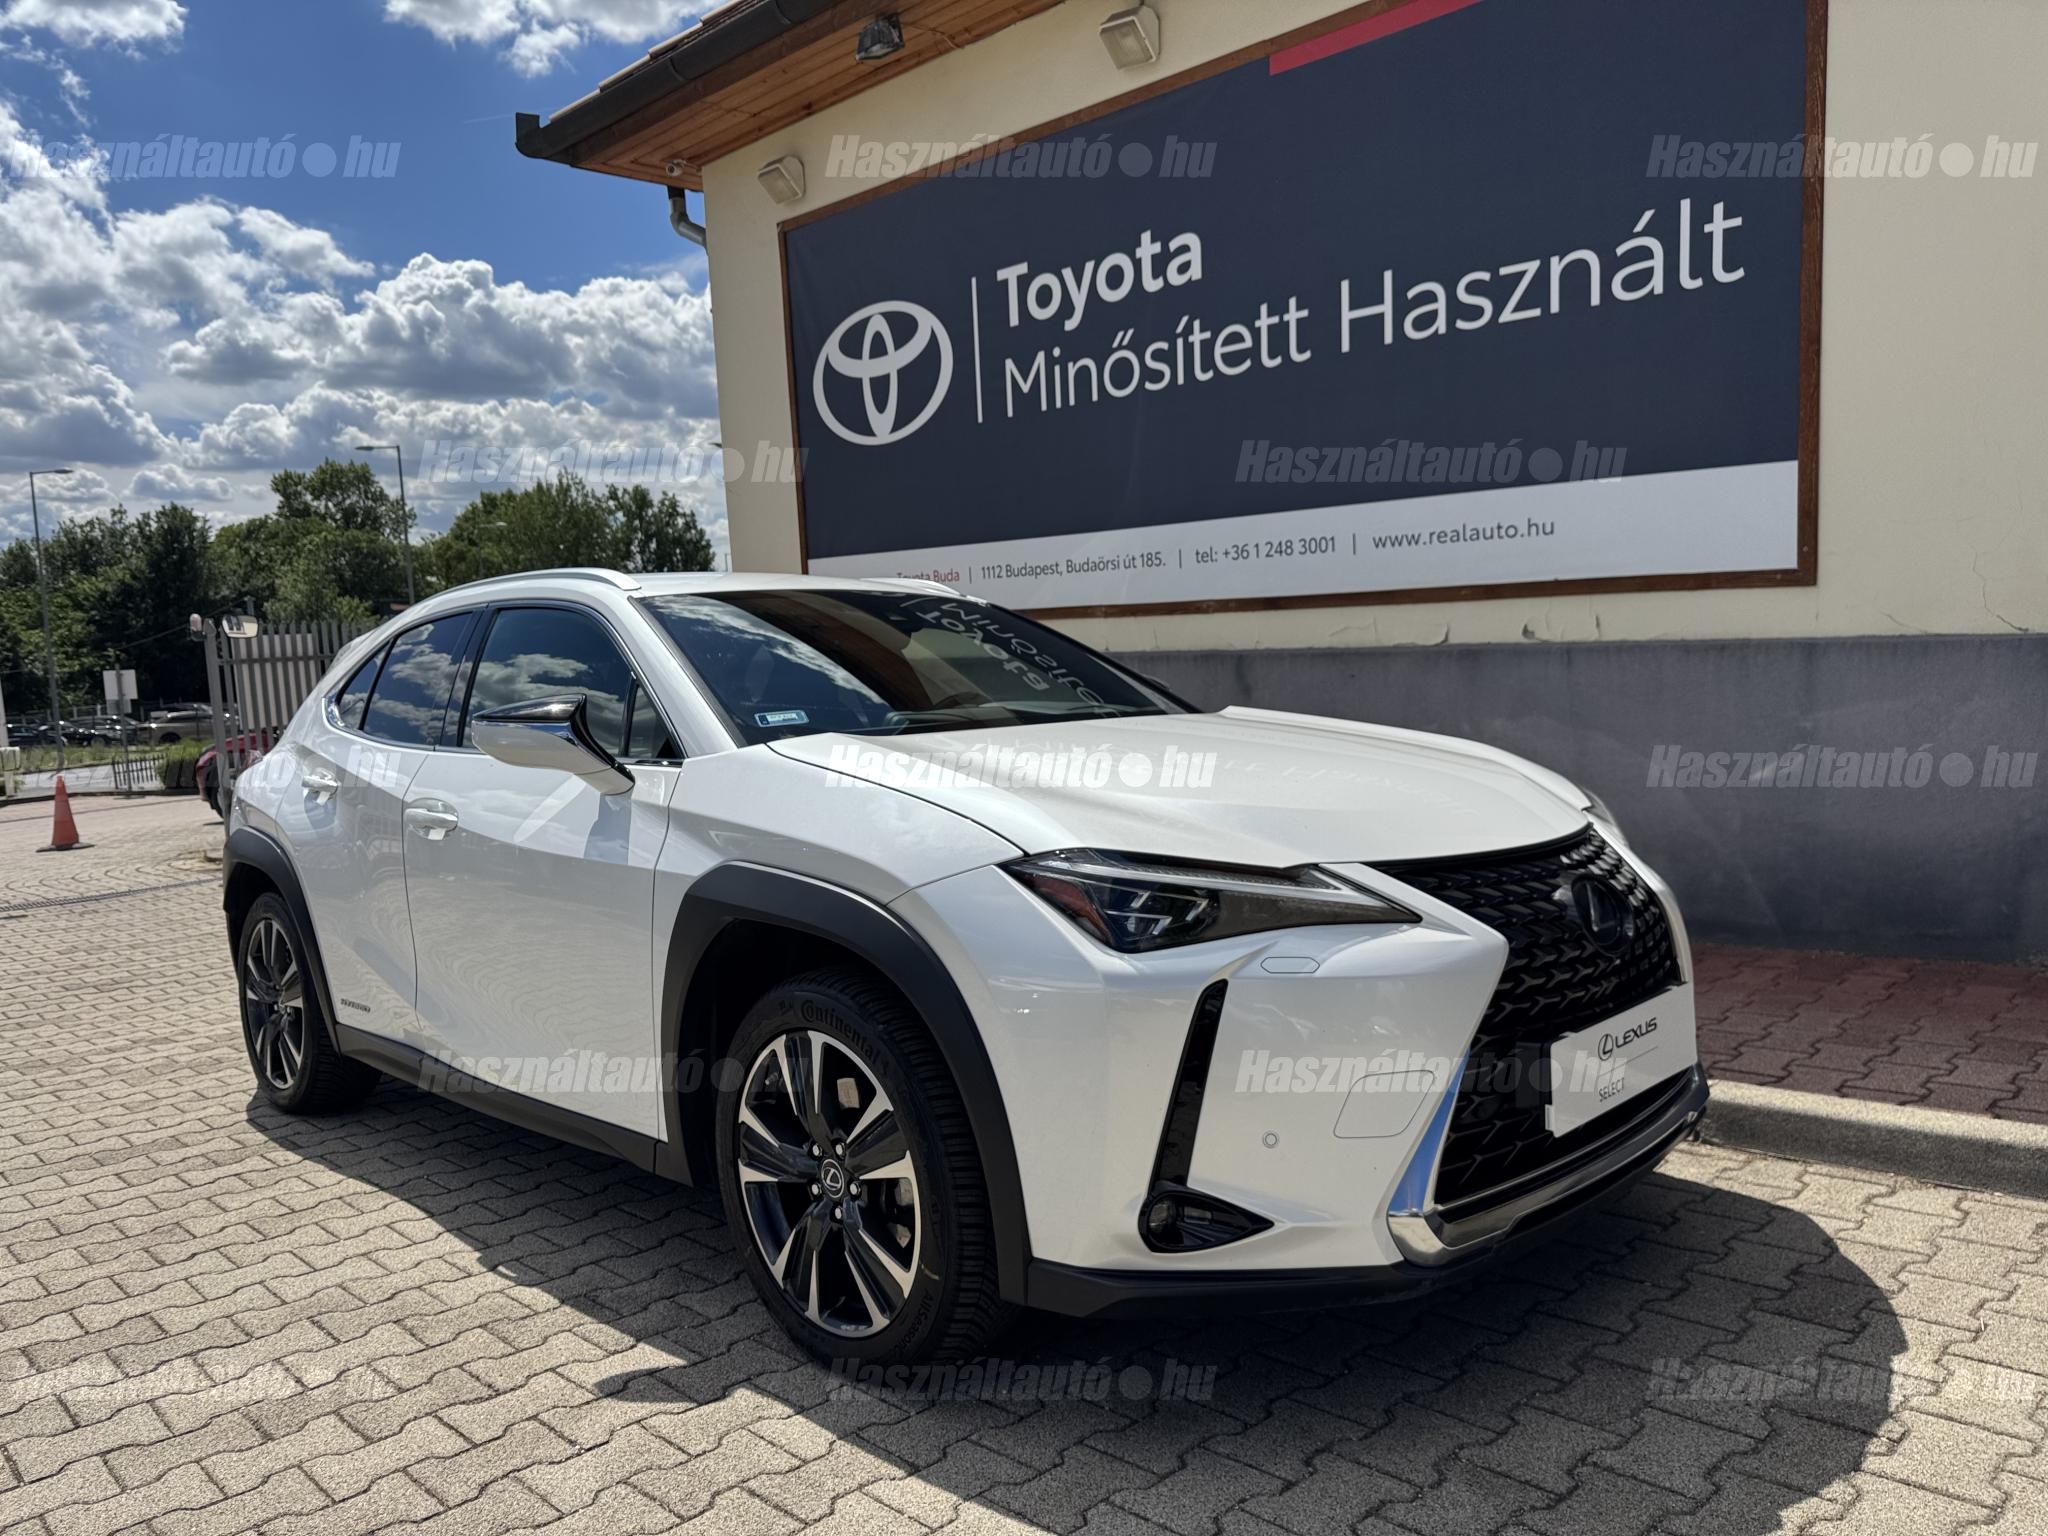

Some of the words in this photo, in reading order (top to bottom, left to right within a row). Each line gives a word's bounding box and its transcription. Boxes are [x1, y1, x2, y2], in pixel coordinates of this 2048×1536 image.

[996, 229, 1203, 332] Toyota
[1004, 296, 1312, 418] Minősített
[1339, 197, 1746, 354] Használt
[932, 568, 960, 582] Buda
[981, 564, 1003, 580] 1112
[1005, 560, 1063, 580] Budapest,
[1066, 555, 1120, 574] Budaörsi
[1123, 553, 1137, 570] út
[1140, 550, 1166, 568] 185.
[1195, 548, 1218, 564] tel:
[1222, 542, 1250, 562] +36
[1253, 542, 1261, 559] 1
[1264, 538, 1294, 559] 248
[1298, 535, 1336, 556] 3001
[1372, 517, 1555, 550] www.realauto.hu
[800, 999, 881, 1064] Continental
[1615, 1017, 1658, 1049] LEXUS
[1598, 1077, 1625, 1103] SELECT
